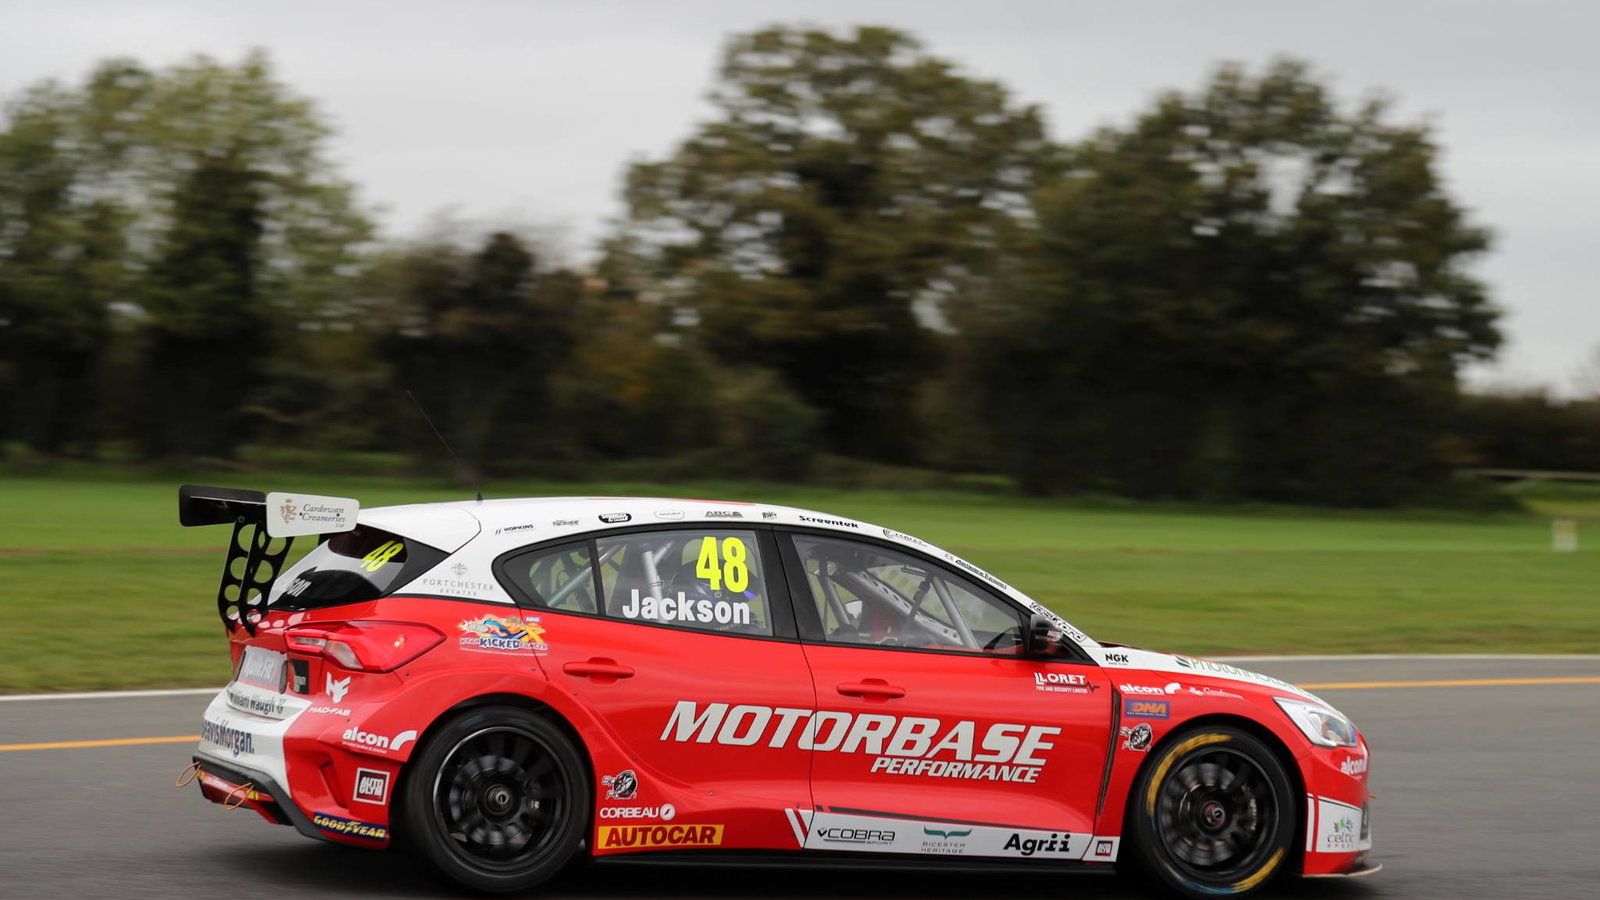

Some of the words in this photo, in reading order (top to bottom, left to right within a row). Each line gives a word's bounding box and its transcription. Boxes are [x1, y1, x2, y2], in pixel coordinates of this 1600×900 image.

[303, 503, 345, 514] Cardowan
[301, 512, 346, 523] Creameries
[798, 515, 859, 528] Screentek
[503, 523, 534, 532] HOPKINS
[360, 540, 404, 573] 48
[696, 536, 749, 593] 48
[422, 578, 495, 592] PORTCHESTER
[440, 588, 477, 597] ESTATES
[622, 589, 750, 625] Jackson
[479, 637, 520, 649] KICKED
[1105, 653, 1129, 663] NGK
[1034, 672, 1086, 685] LLORET
[1119, 683, 1165, 695] alcon
[308, 706, 352, 716] HAD-FAB
[1132, 702, 1167, 714] DNA
[342, 726, 389, 748] alcon
[660, 700, 1062, 766] MOTORBASE
[870, 757, 1042, 784] PERFORMANCE
[599, 807, 659, 818] CORBEAU
[313, 815, 386, 838] GOODYEAR
[605, 826, 717, 847] AUTOCAR
[827, 828, 896, 842] COBRA
[1003, 833, 1071, 856] Agrii
